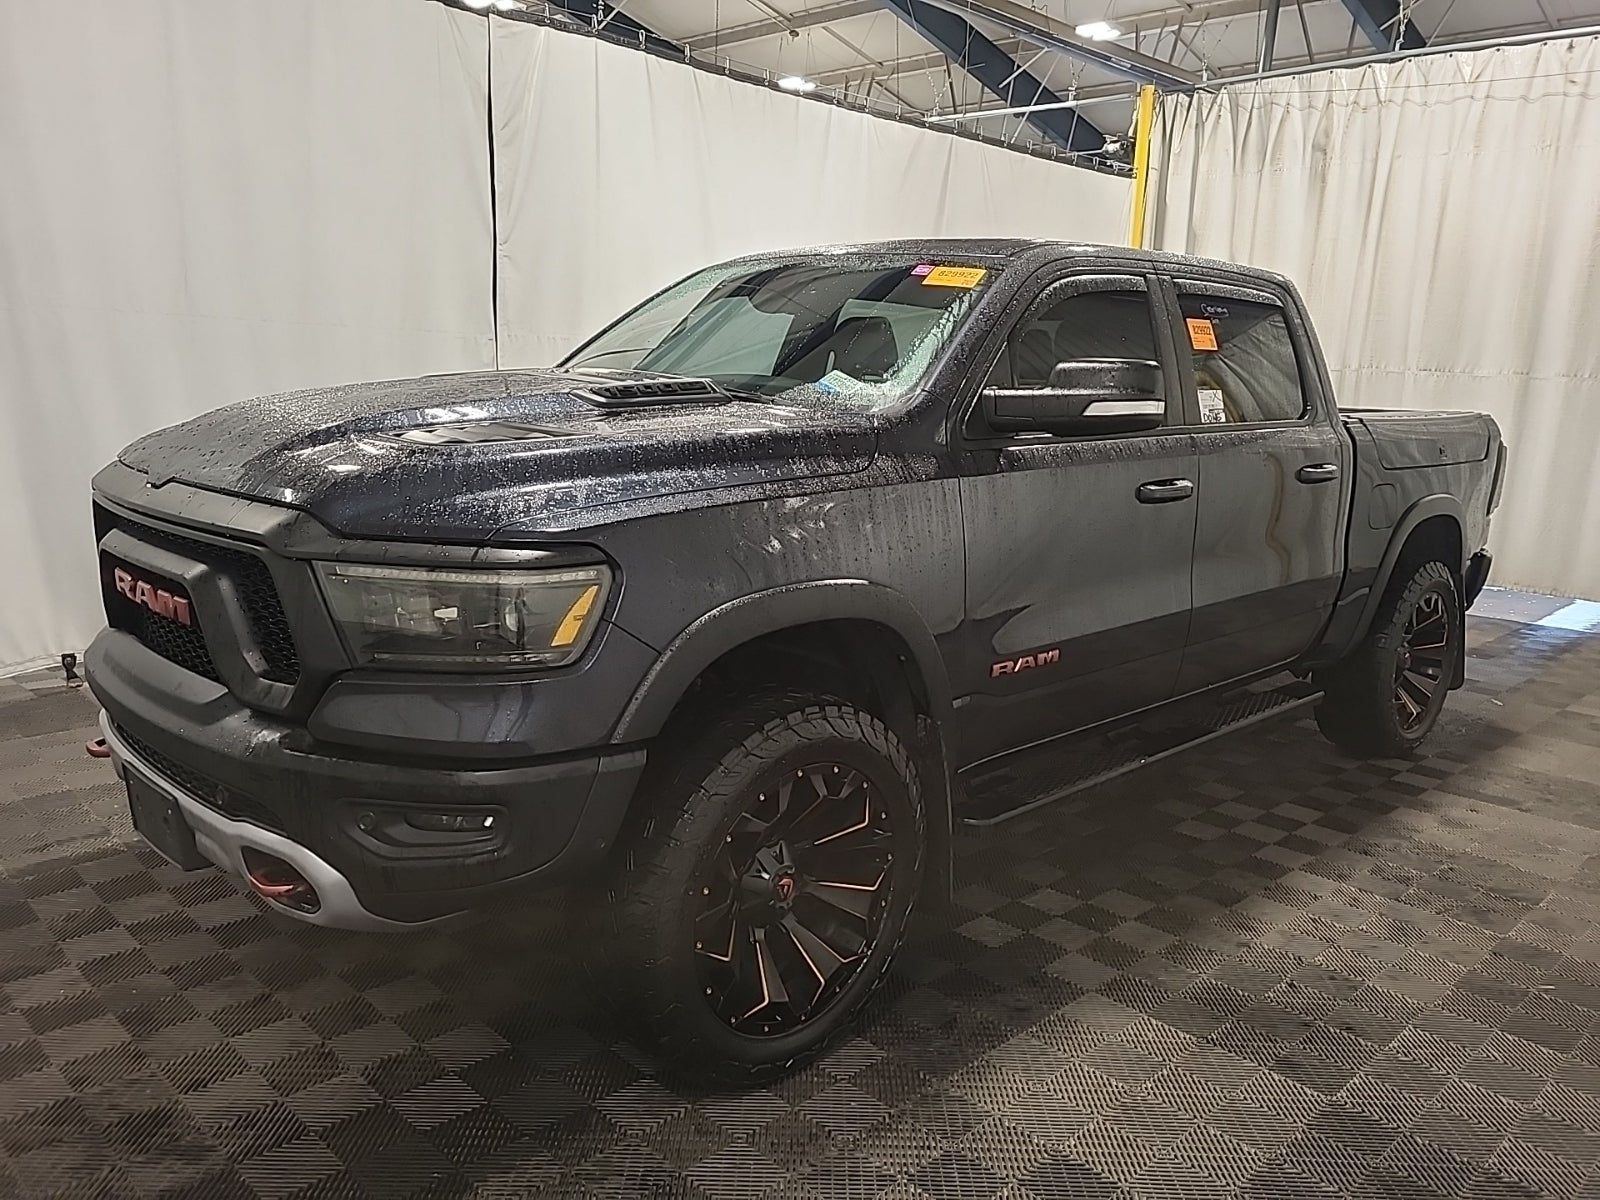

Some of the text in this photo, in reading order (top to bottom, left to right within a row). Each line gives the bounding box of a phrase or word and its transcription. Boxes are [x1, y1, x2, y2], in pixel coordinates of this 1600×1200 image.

[937, 270, 979, 279] 829922
[1192, 325, 1212, 335] 829922
[114, 566, 191, 626] RAM
[991, 649, 1060, 678] RAM
